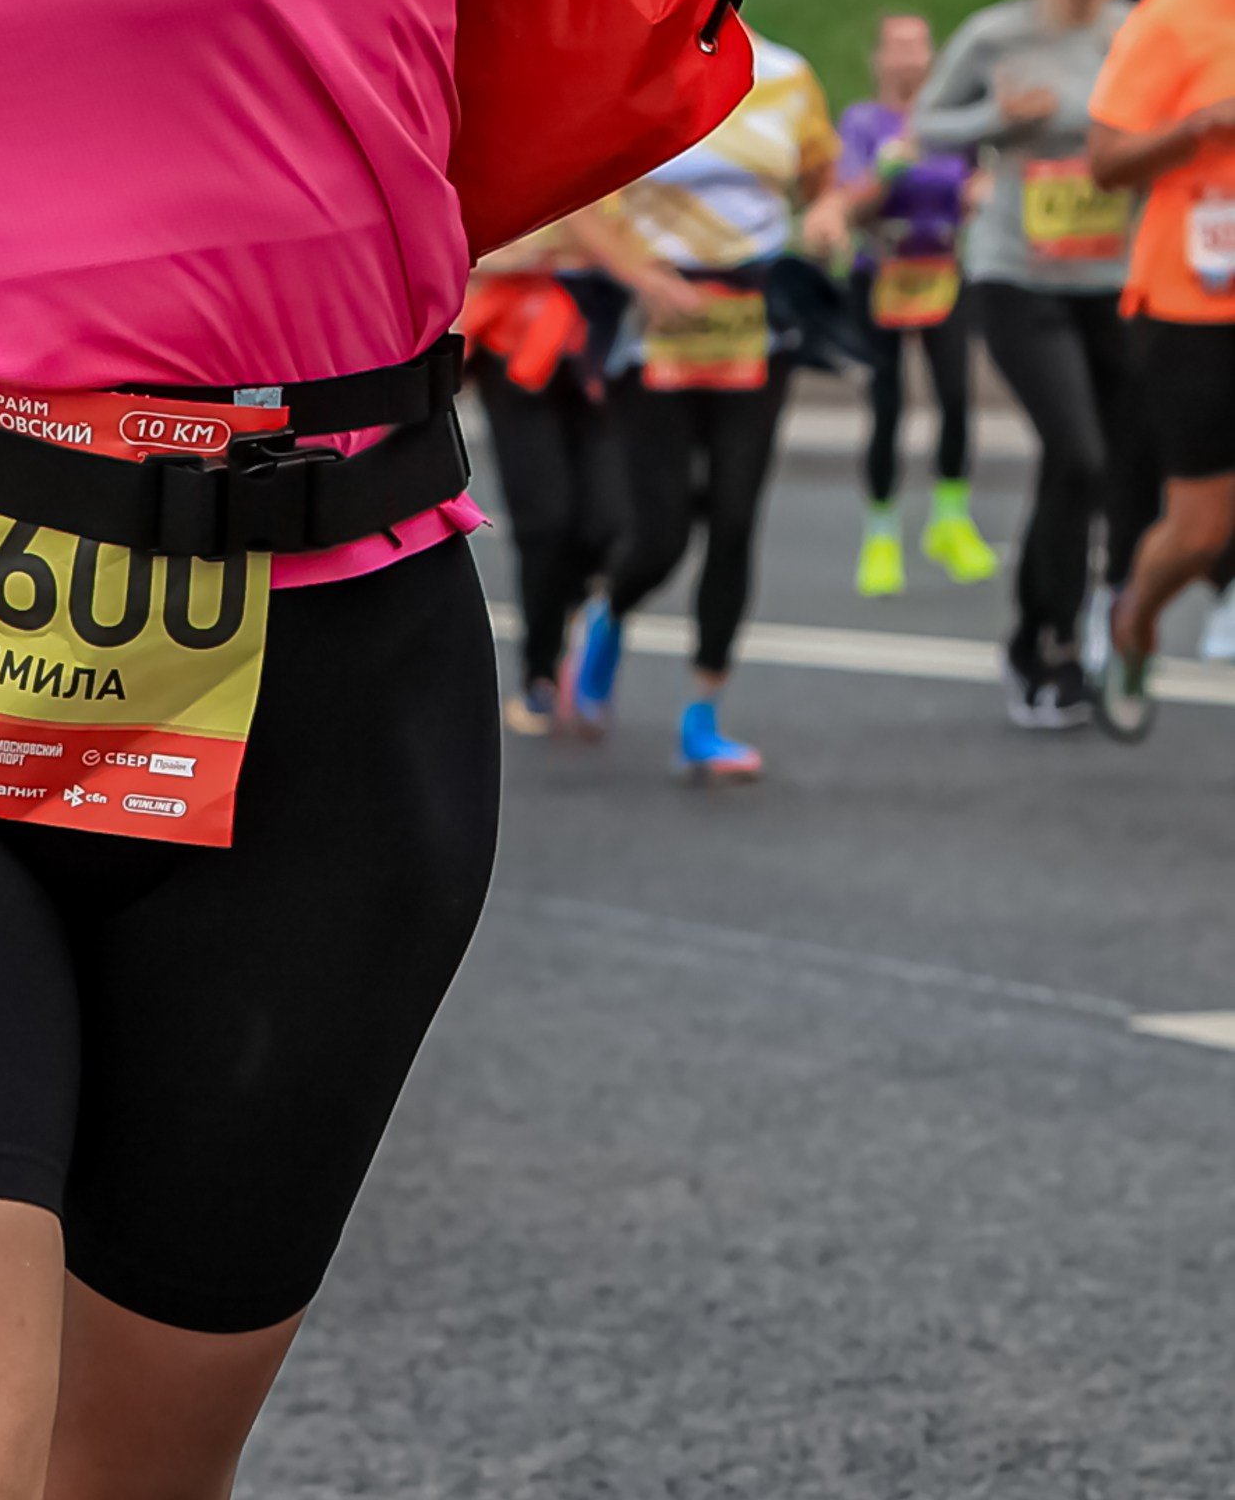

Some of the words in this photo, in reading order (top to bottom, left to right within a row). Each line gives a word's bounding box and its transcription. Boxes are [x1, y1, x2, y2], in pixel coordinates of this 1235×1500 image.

[137, 418, 165, 439] 10
[105, 752, 148, 768] СБЕР
[85, 793, 108, 804] сбп
[127, 798, 172, 813] WINLINE
